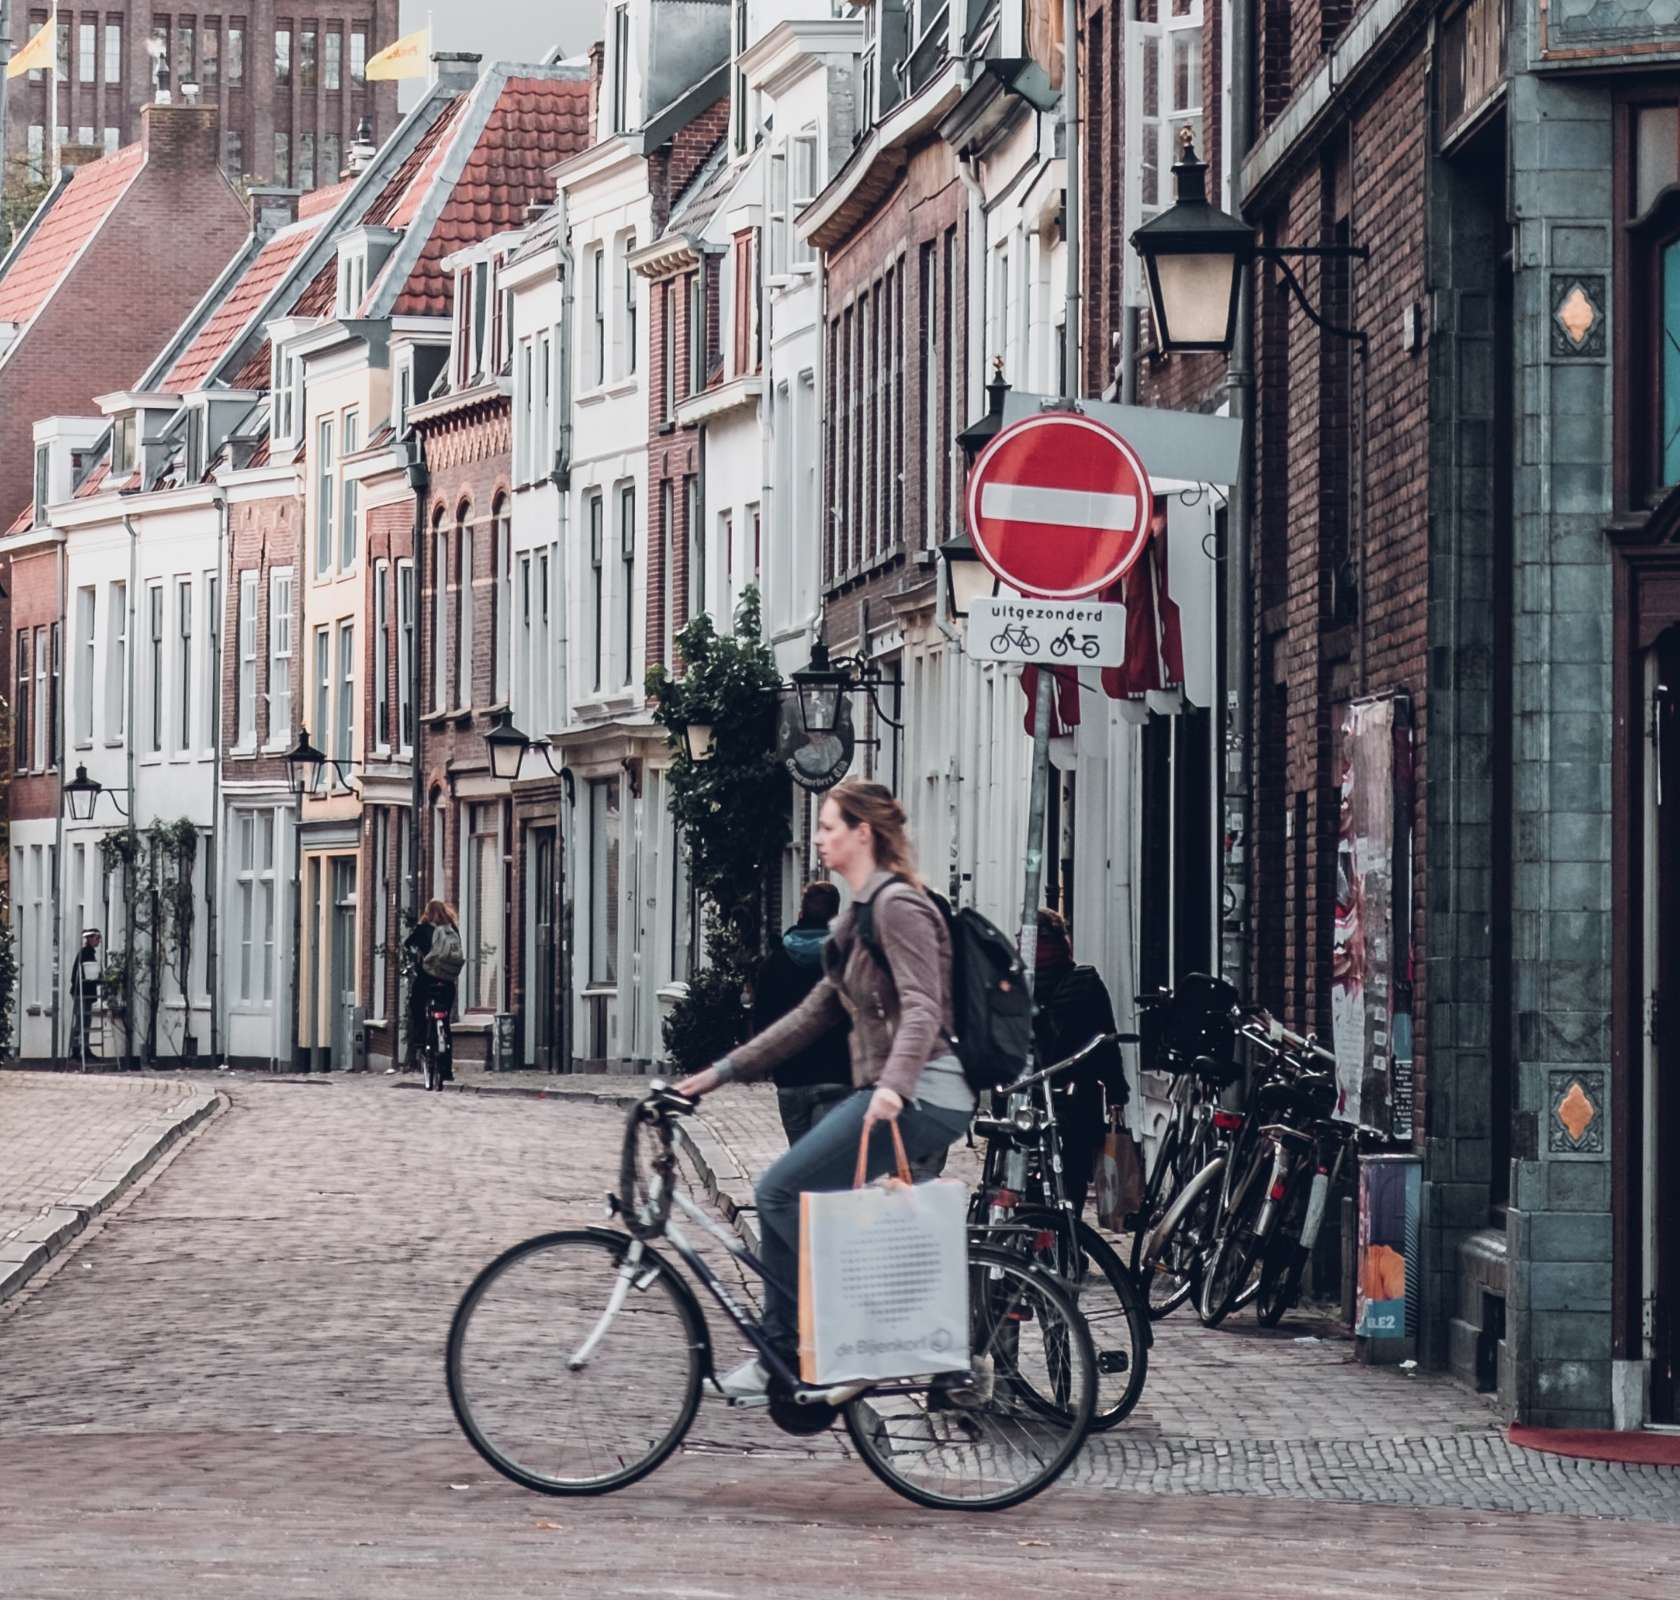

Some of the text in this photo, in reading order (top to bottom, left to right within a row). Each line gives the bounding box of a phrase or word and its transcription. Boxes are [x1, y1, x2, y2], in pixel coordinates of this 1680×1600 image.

[992, 605, 1103, 622] uitgezonderd
[1367, 1315, 1396, 1329] ELE2
[834, 1336, 928, 1357] de Bijenkorf
